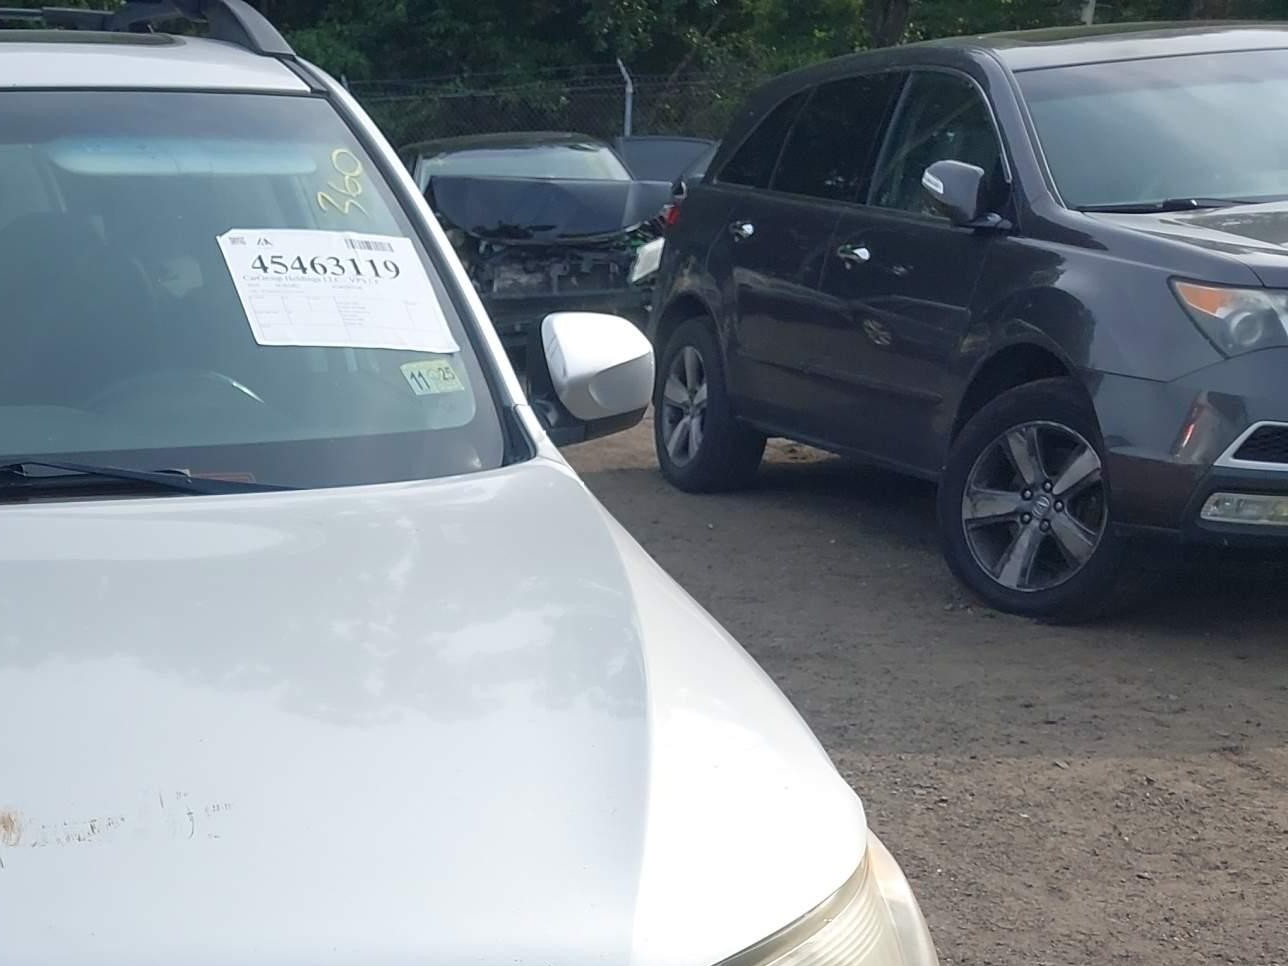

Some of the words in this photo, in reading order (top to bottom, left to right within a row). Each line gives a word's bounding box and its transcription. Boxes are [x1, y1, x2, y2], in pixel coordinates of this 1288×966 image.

[317, 148, 369, 218] 360
[250, 254, 401, 281] 45463119
[410, 371, 430, 390] 11
